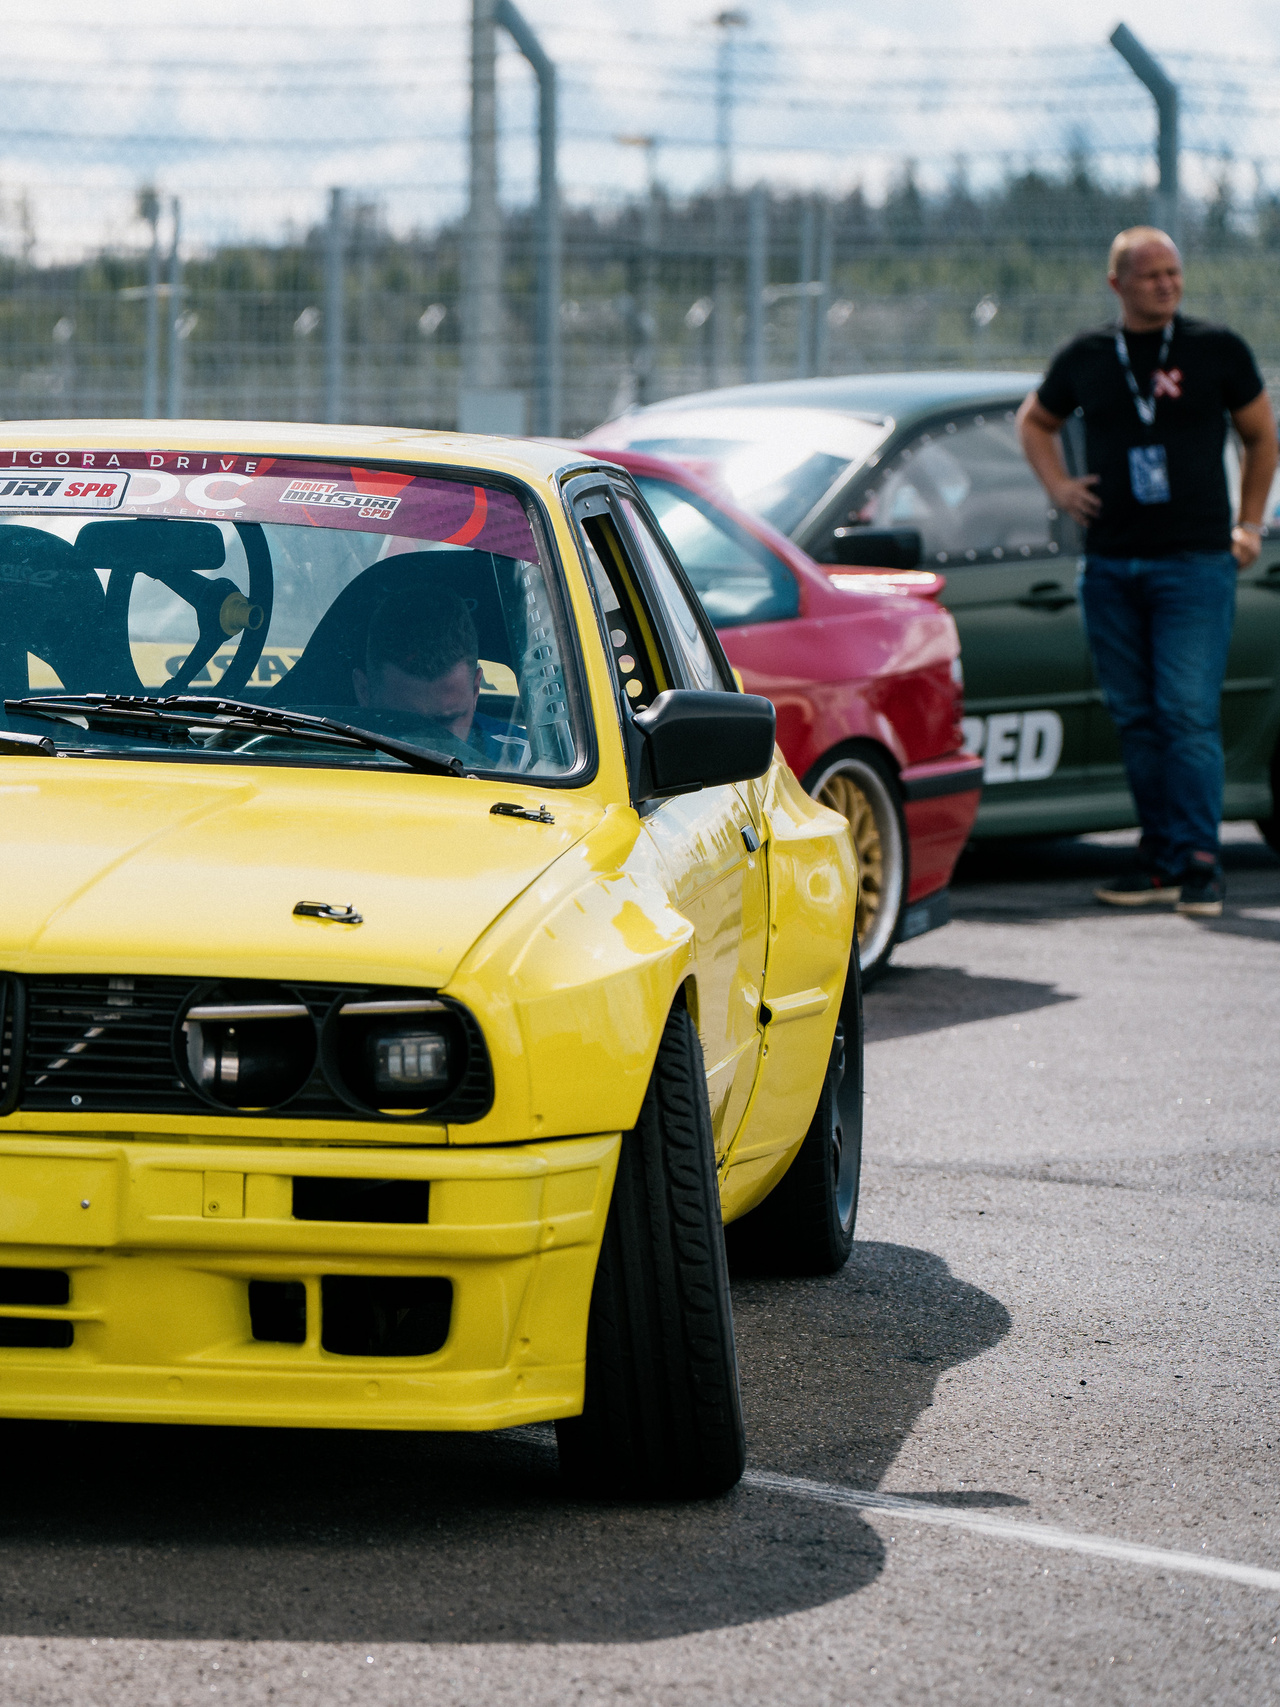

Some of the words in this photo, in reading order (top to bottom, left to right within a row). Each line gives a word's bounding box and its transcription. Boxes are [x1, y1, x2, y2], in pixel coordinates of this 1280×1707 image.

[11, 451, 121, 467] IGORA
[149, 454, 257, 473] DRIVE
[63, 482, 118, 498] SPB
[289, 481, 336, 493] DRIFT
[282, 490, 399, 510] MATSURI
[127, 505, 244, 518] ALLENGE
[360, 507, 392, 519] SPB
